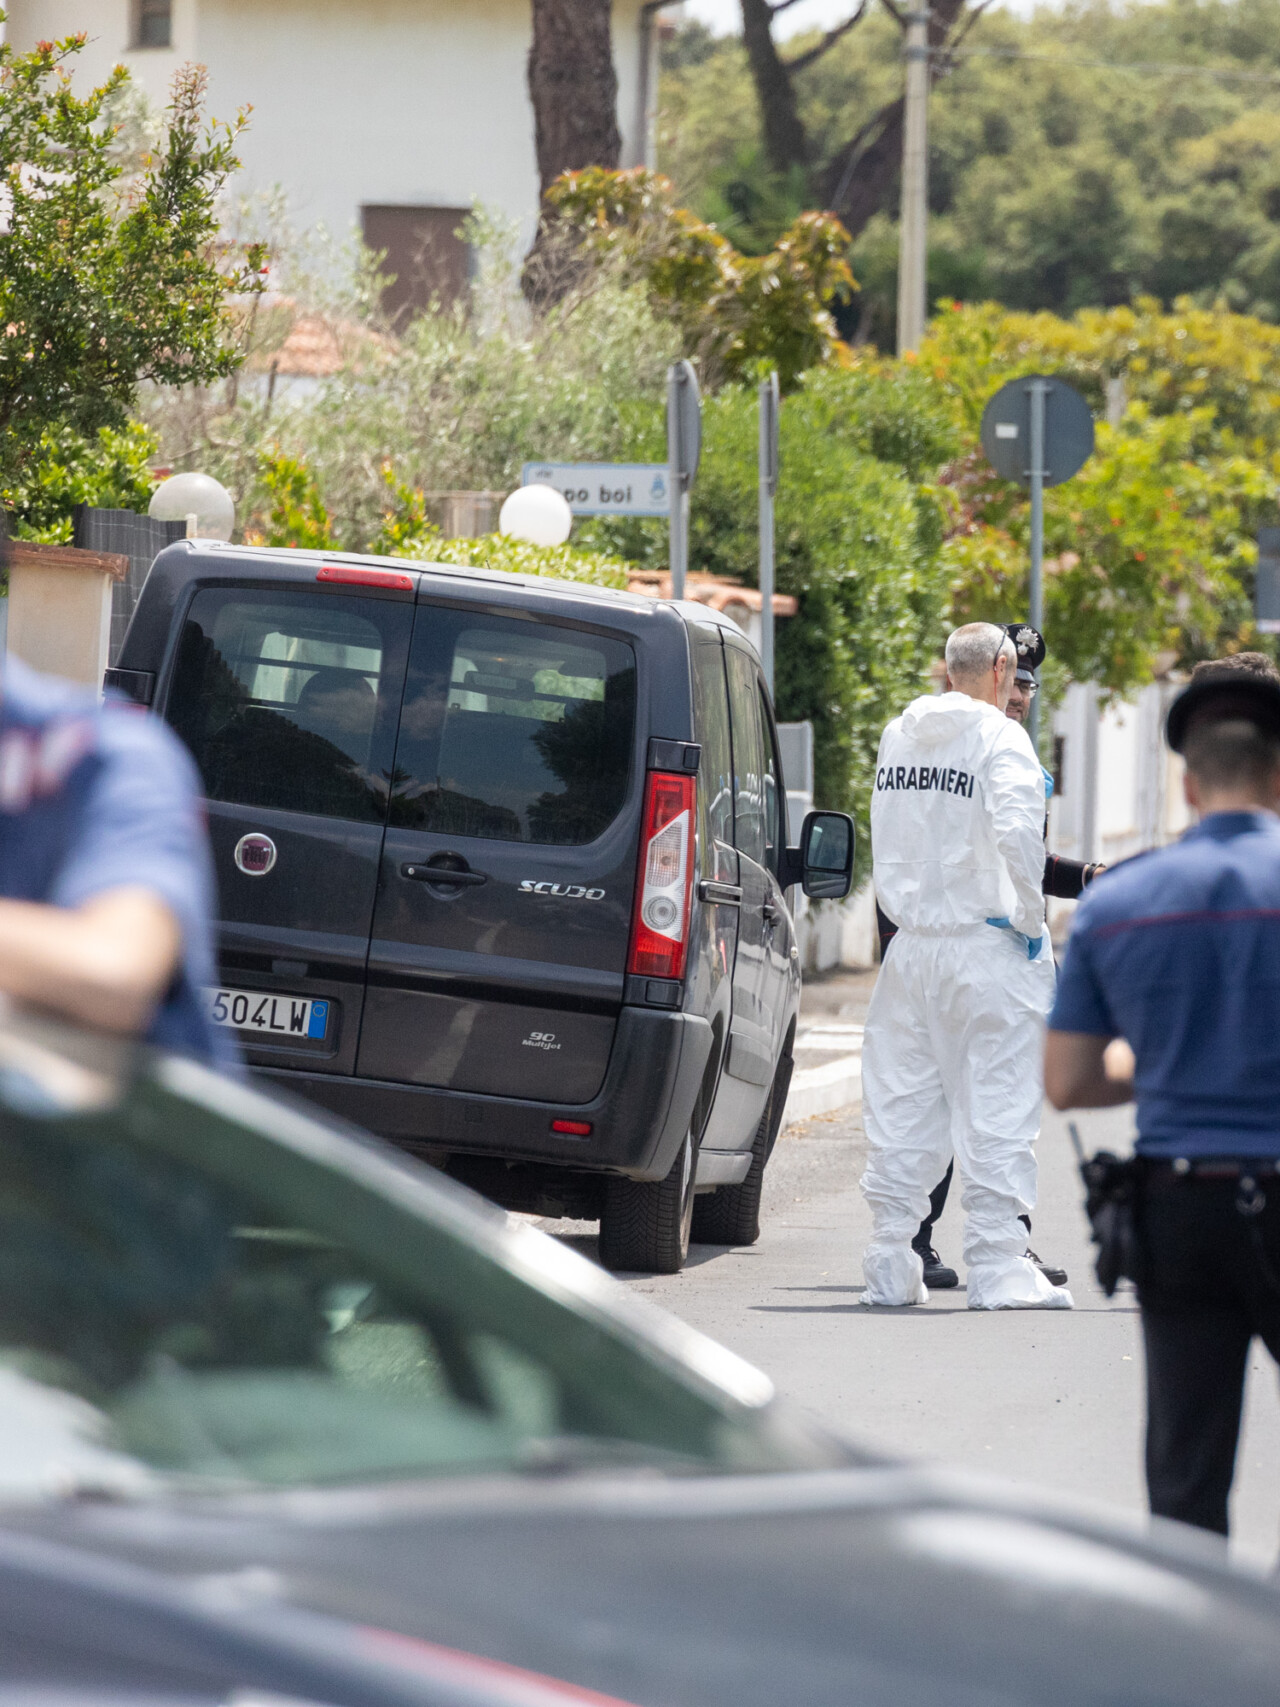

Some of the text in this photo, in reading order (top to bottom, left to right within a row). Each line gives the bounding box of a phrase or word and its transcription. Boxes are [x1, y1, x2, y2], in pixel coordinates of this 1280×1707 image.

[600, 485, 632, 503] boi
[877, 766, 975, 798] CARABNIERI
[517, 880, 606, 901] SCUDO
[212, 991, 307, 1033] 504LW
[529, 1031, 555, 1042] 90
